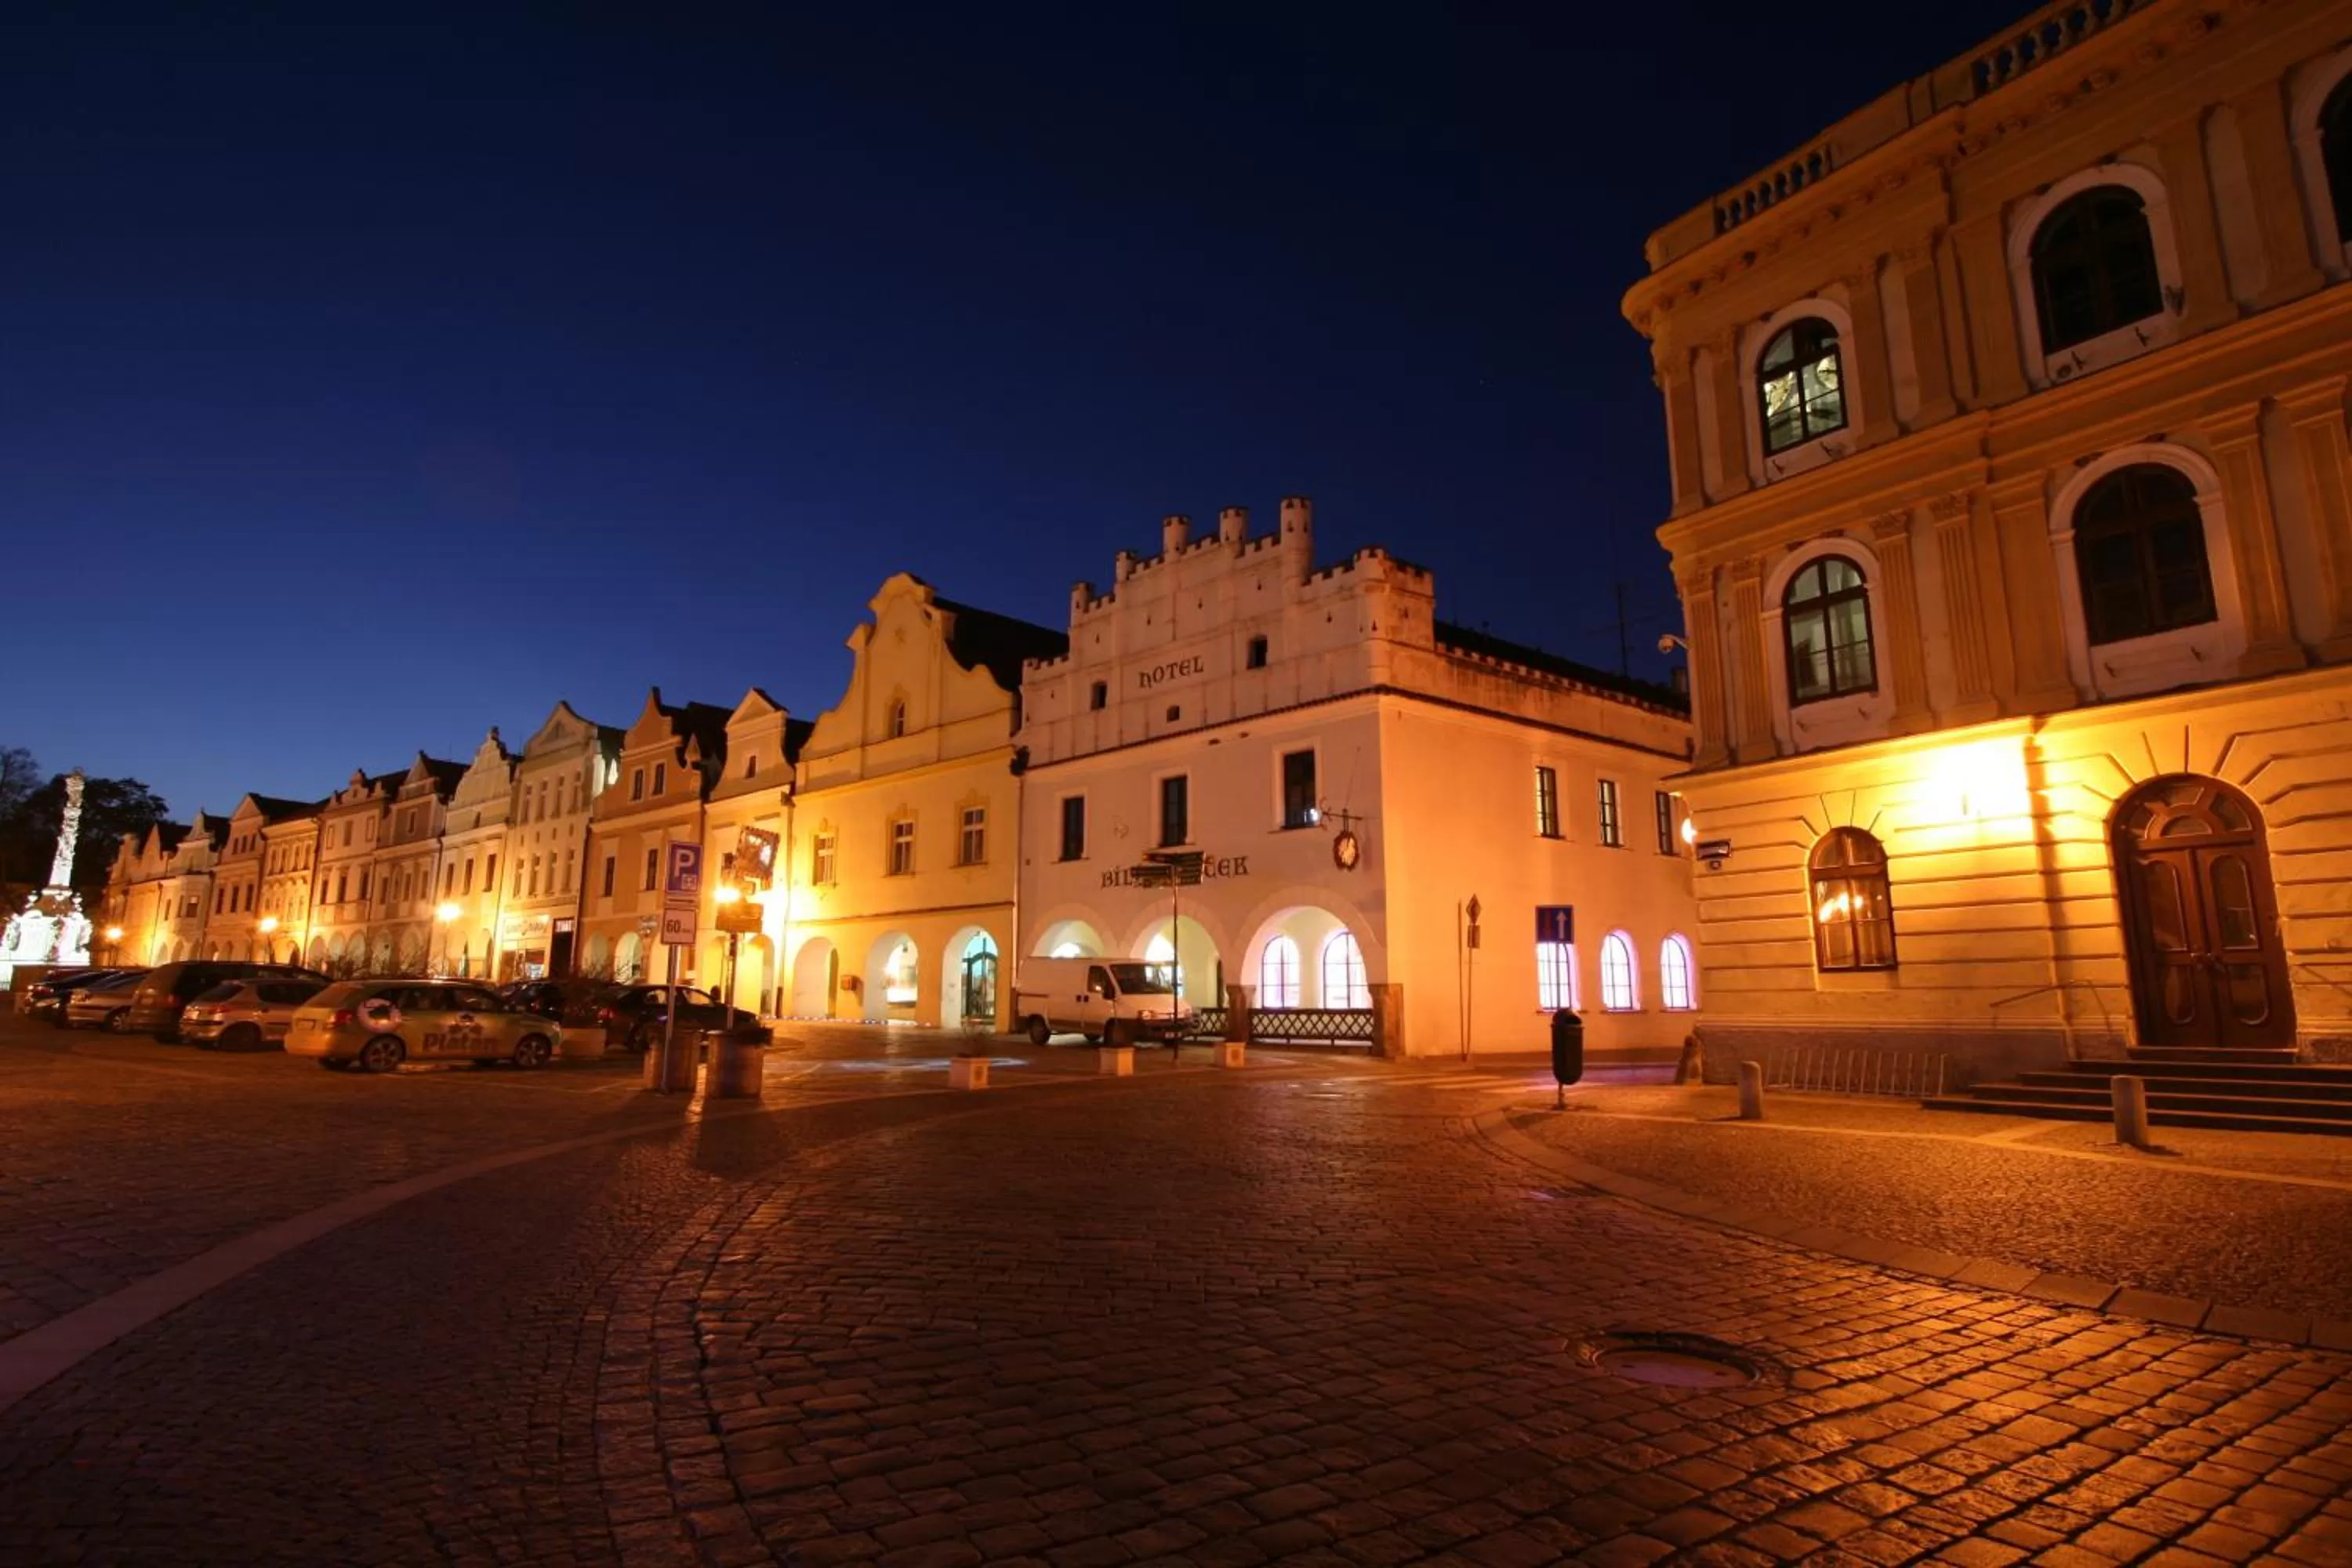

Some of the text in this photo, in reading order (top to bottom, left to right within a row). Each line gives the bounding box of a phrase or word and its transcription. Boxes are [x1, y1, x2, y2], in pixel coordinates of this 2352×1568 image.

[1138, 655, 1204, 689] HOTEL
[674, 849, 695, 877] P
[666, 919, 681, 934] 60
